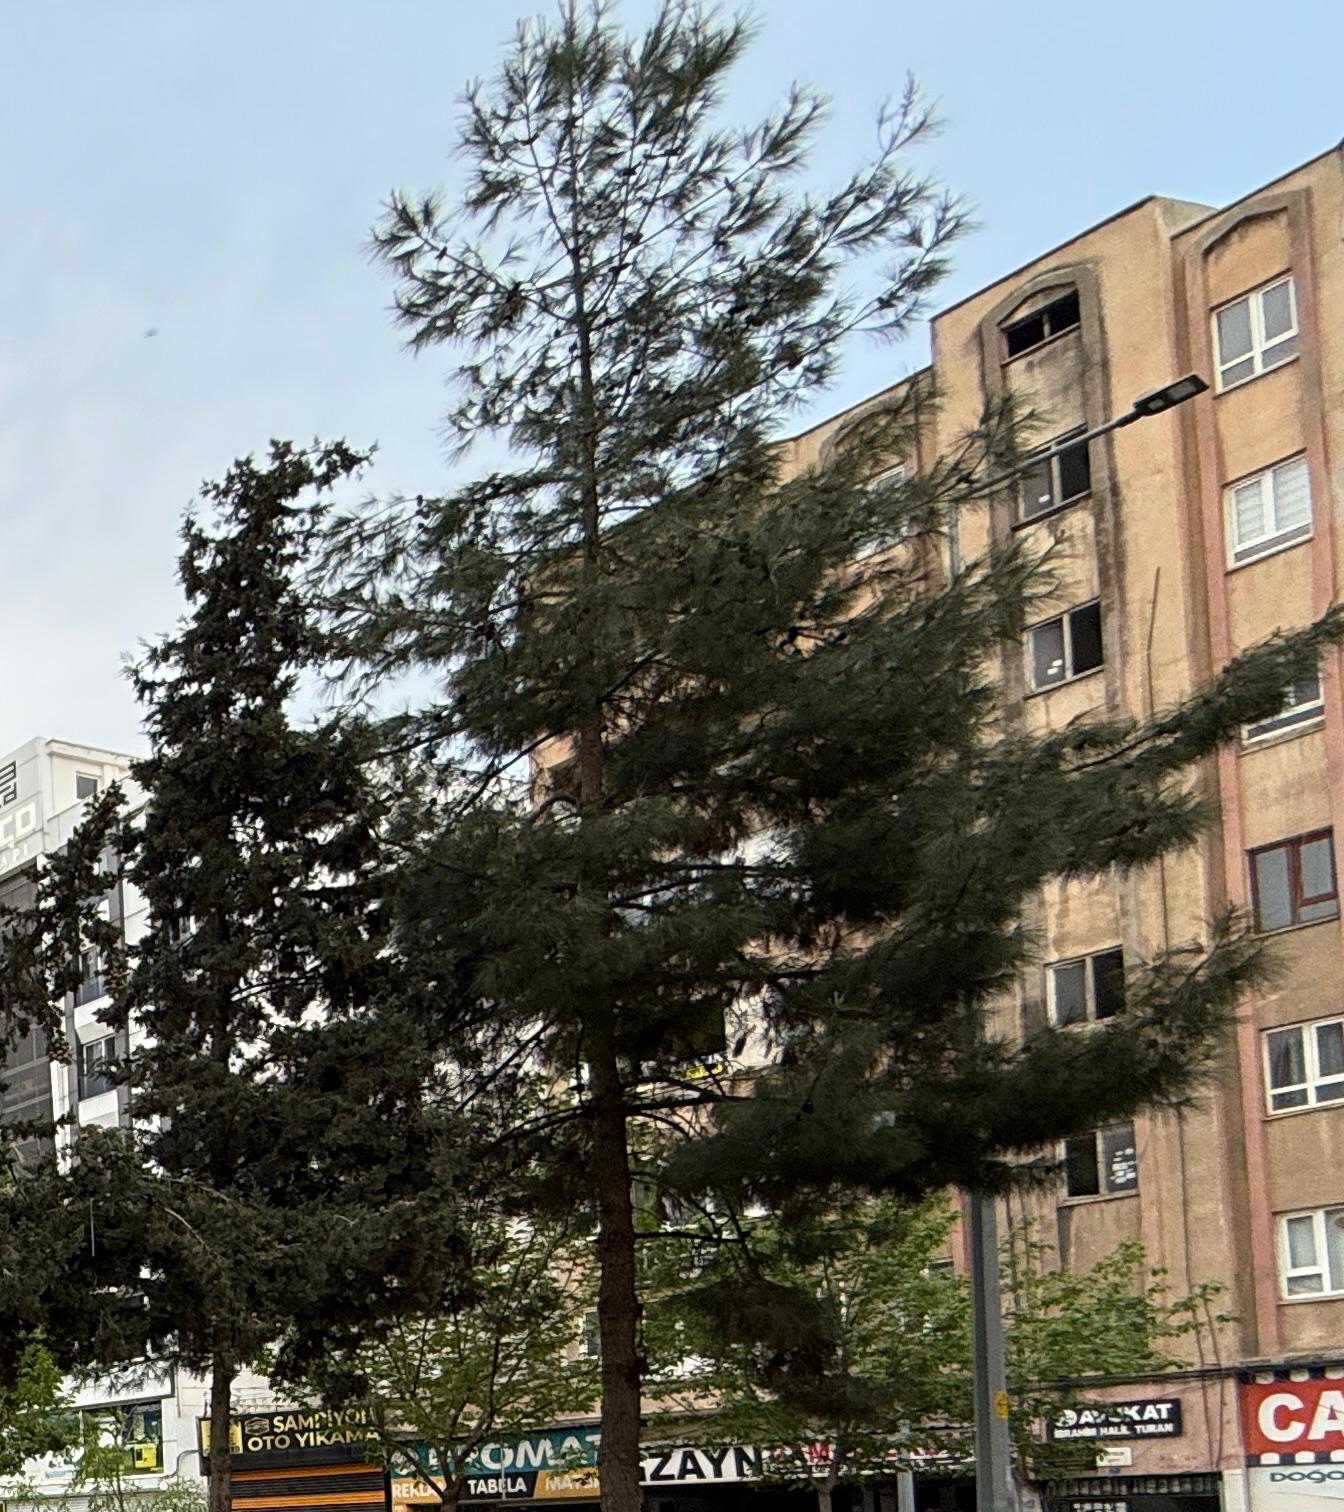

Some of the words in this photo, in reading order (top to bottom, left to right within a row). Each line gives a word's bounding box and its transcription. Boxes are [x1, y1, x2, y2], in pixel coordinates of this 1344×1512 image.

[248, 1436, 291, 1451] OTO
[639, 1446, 762, 1481] ZAYN
[393, 1481, 448, 1498] REKLA
[467, 1477, 527, 1495] TABELA
